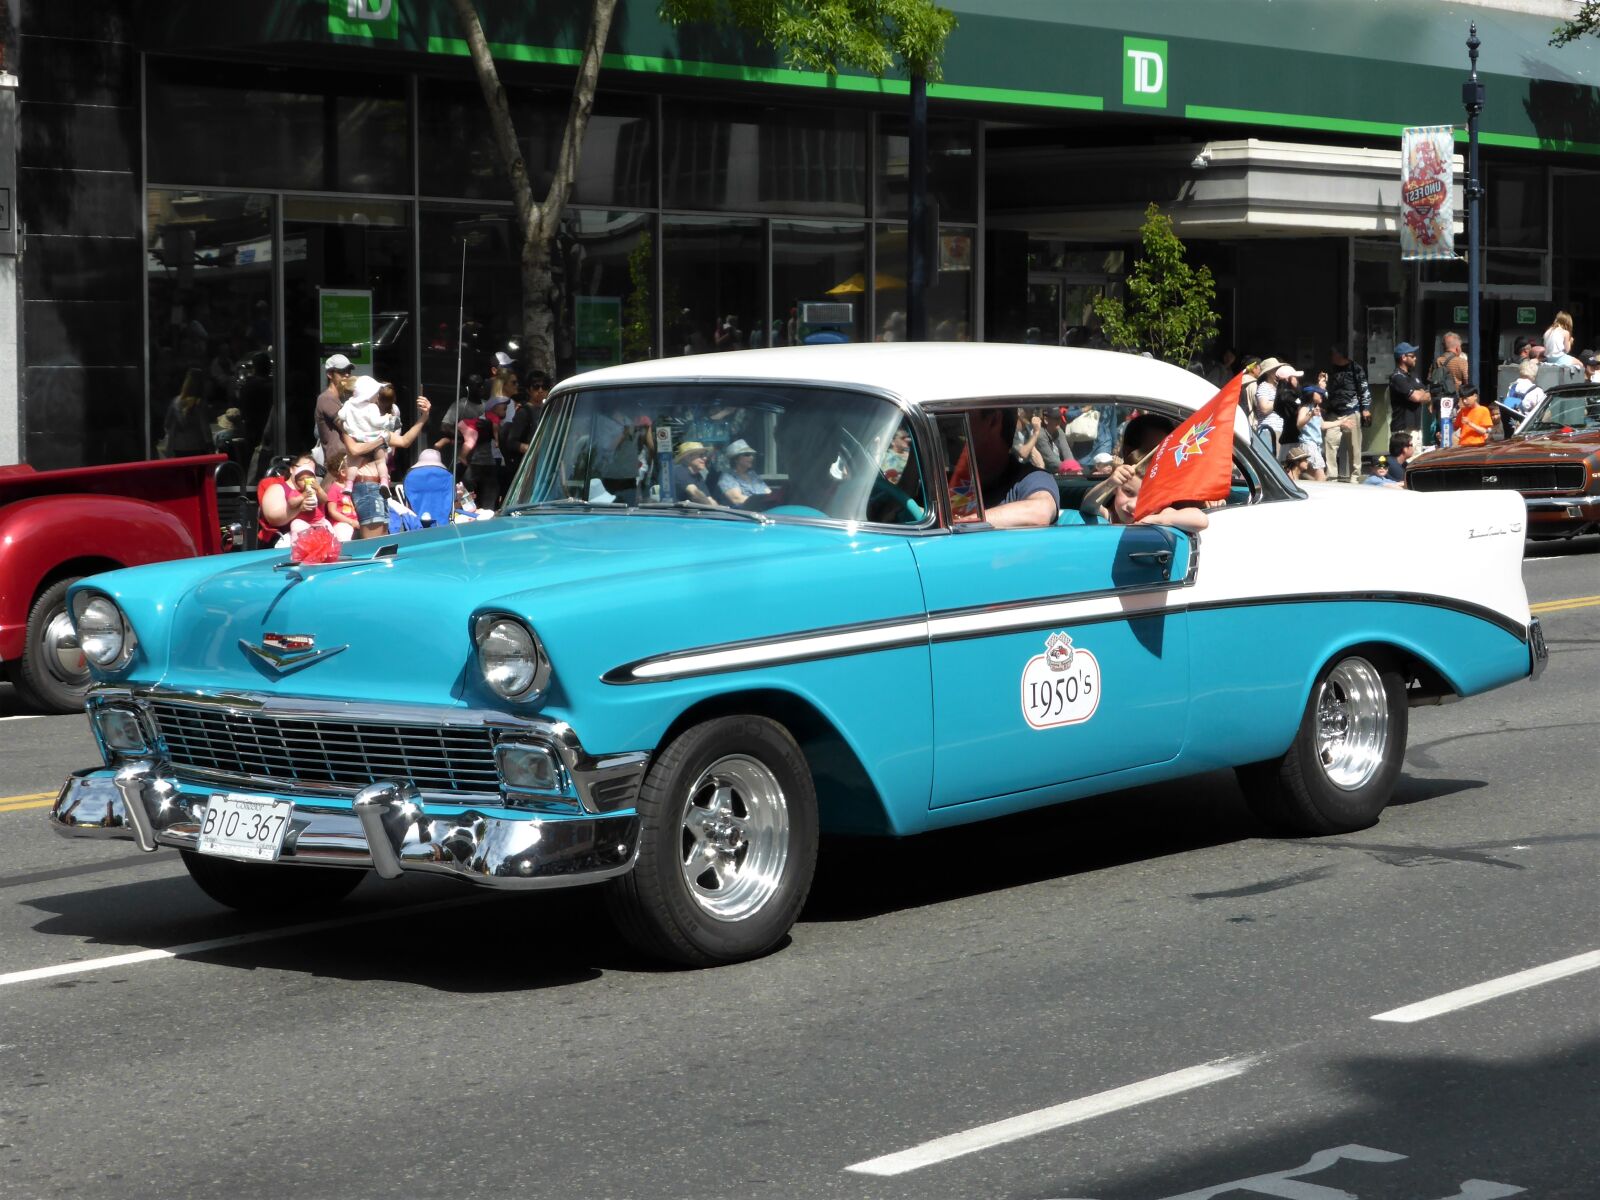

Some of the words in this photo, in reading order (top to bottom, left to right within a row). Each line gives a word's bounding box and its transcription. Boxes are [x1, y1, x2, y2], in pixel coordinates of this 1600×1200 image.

[1127, 49, 1164, 93] TD
[1029, 668, 1092, 718] 1950's
[202, 808, 286, 843] B10-367
